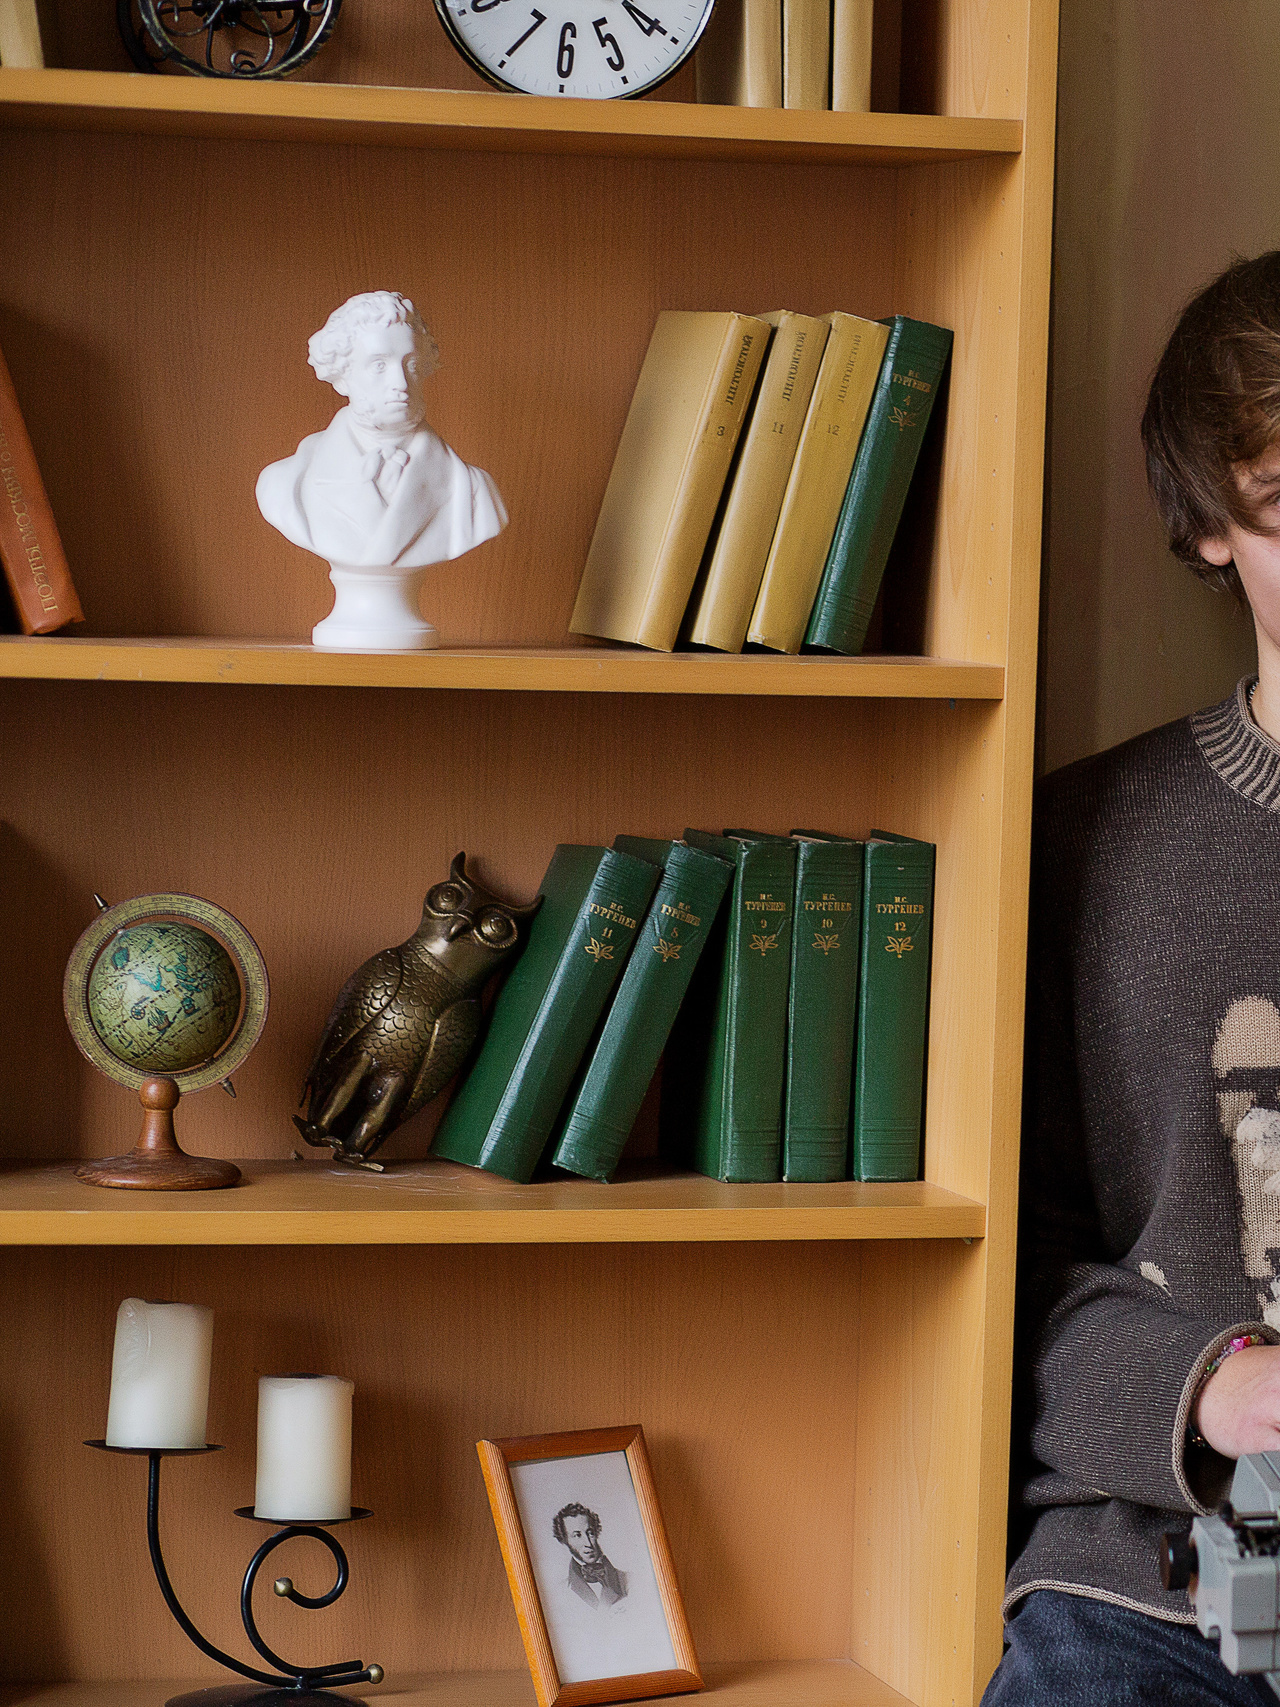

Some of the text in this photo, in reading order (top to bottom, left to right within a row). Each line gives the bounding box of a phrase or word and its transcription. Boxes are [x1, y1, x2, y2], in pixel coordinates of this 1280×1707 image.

[622, 0, 668, 36] 4
[505, 8, 547, 57] 7
[556, 22, 577, 78] 6
[592, 16, 625, 72] 5
[716, 425, 725, 437] 3
[772, 421, 785, 435] 11
[827, 423, 841, 436] 12
[1, 466, 37, 543] МОСКВЫ
[25, 544, 58, 613] ПОЭТЫ
[745, 901, 786, 911] ТУРГЕНЕВ
[803, 901, 852, 912] ТУРГЕНЕВ
[875, 903, 925, 914] ТУРГЕНЕВ
[590, 903, 637, 929] ТУРГЕНЕВ
[661, 904, 701, 927] ТУРГЕНЕВ
[760, 919, 767, 929] 9
[821, 919, 834, 929] 10
[894, 921, 907, 931] 12
[602, 927, 613, 939] 11
[671, 927, 679, 938] 8
